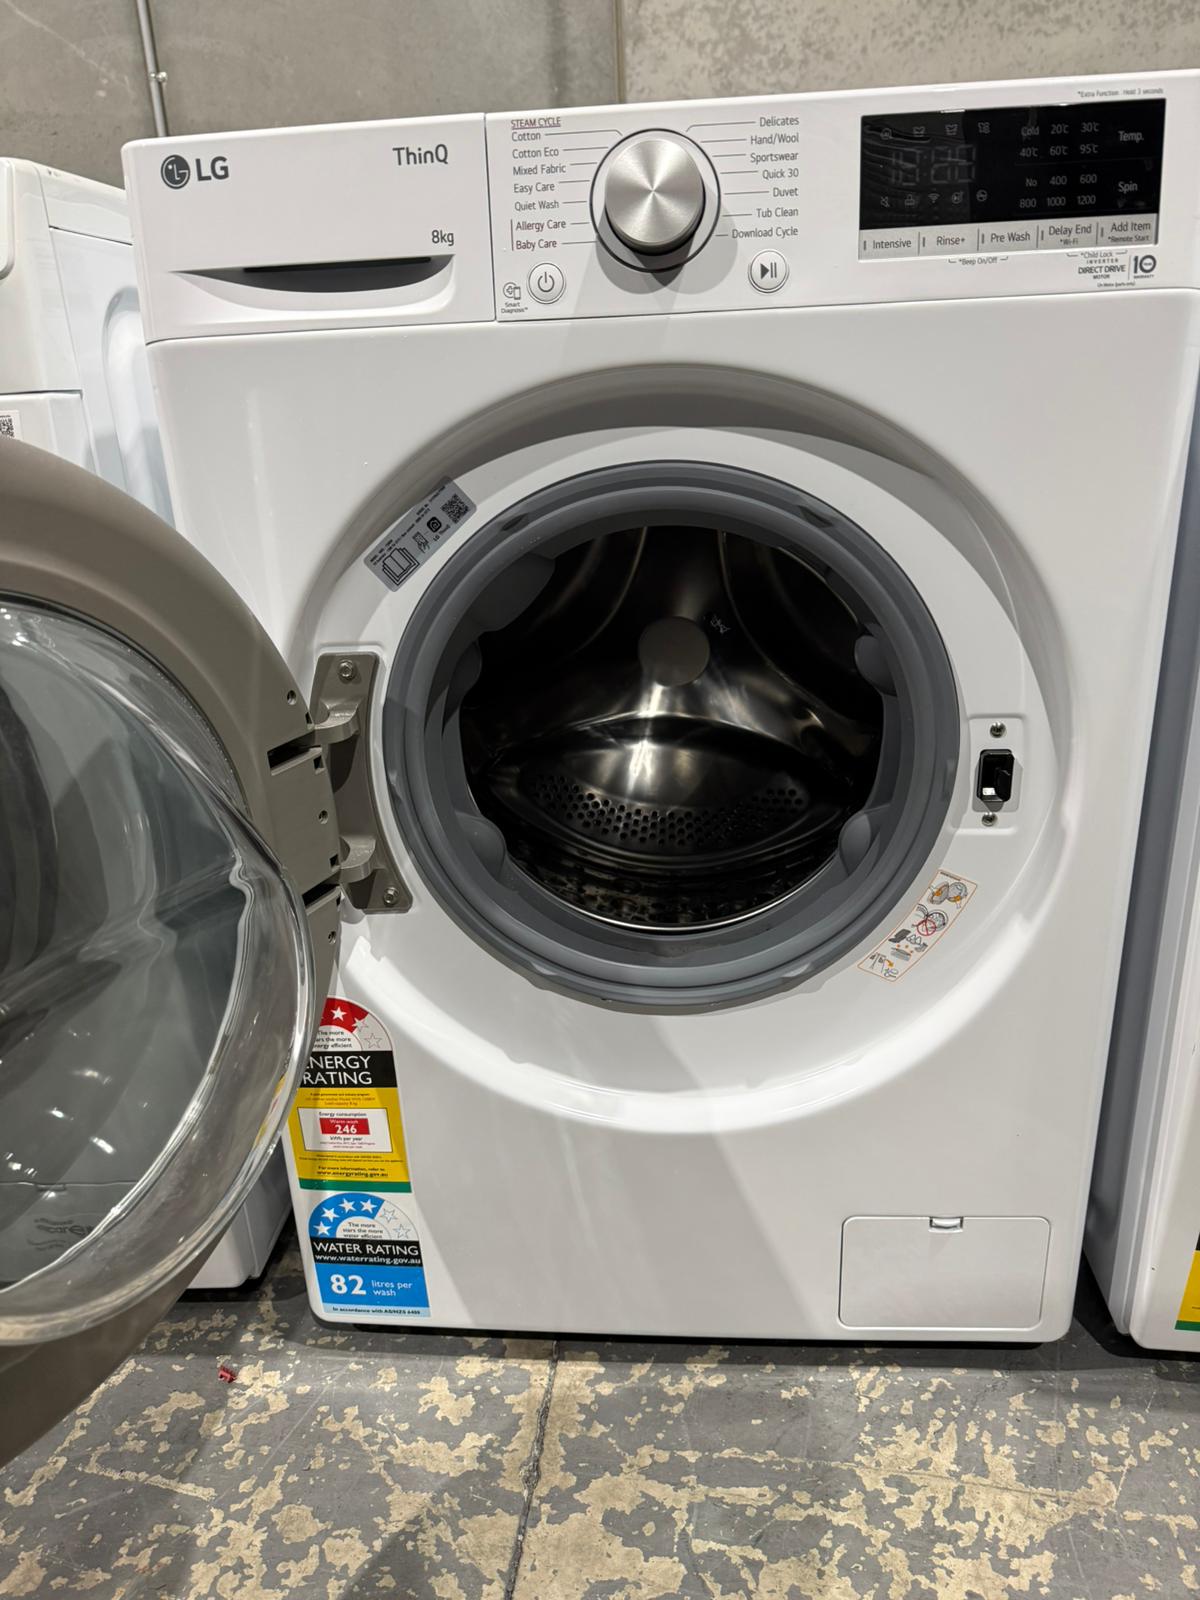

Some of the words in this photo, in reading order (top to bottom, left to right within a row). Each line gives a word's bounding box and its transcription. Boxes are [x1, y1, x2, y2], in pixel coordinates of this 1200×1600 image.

[511, 118, 537, 128] STEAM
[538, 117, 561, 127] CYCLE
[760, 116, 799, 127] Delicates
[512, 131, 541, 141] Cotton
[1021, 126, 1039, 136] Cold
[1118, 130, 1144, 142] Temp.
[751, 133, 799, 145] Hand/Wool
[392, 144, 448, 166] ThinQ
[512, 150, 542, 159] Cotton
[544, 148, 559, 157] Eco
[750, 152, 799, 165] Sportswear
[196, 156, 230, 182] LG
[513, 165, 538, 175] Mixed
[541, 164, 566, 174] Fabric
[762, 169, 785, 180] Quick
[788, 168, 799, 178] 30
[1026, 178, 1037, 187] No
[1050, 176, 1067, 185] 400
[1080, 174, 1097, 184] 600
[514, 184, 532, 195] Easy
[536, 182, 555, 192] Care
[773, 188, 798, 197] Duvet
[1118, 181, 1137, 193] Spin
[515, 201, 536, 212] Quiet
[538, 200, 559, 209] Wash
[1020, 198, 1036, 208] 800
[1047, 196, 1066, 206] 1000
[1078, 195, 1096, 206] 1200
[756, 208, 772, 218] Tub
[775, 207, 798, 217] Clean
[516, 221, 544, 232] Allergy
[546, 220, 566, 228] Care
[1049, 225, 1073, 236] Delay
[1076, 224, 1092, 234] End
[1110, 222, 1128, 232] Add
[1131, 222, 1150, 232] Item
[431, 230, 454, 246] 8kg
[732, 228, 773, 239] Download
[776, 227, 798, 239] Cycle
[990, 233, 1005, 242] Pre
[1007, 231, 1030, 242] Wash
[1134, 234, 1149, 242] Start
[516, 240, 535, 252] Baby
[538, 239, 557, 248] Care
[873, 239, 912, 249] Intensive
[936, 235, 965, 245] Rinse+
[1078, 266, 1102, 274] DIRECT
[1134, 254, 1157, 274] 10
[306, 1056, 371, 1069] NERGY
[303, 1072, 372, 1085] RATING
[335, 1125, 357, 1134] 246
[314, 1242, 362, 1254] WATER
[366, 1244, 419, 1256] RATING
[315, 1255, 421, 1265] www.waterrating.gov.au
[330, 1274, 366, 1295] 82
[372, 1280, 394, 1288] litres
[373, 1288, 396, 1296] wash
